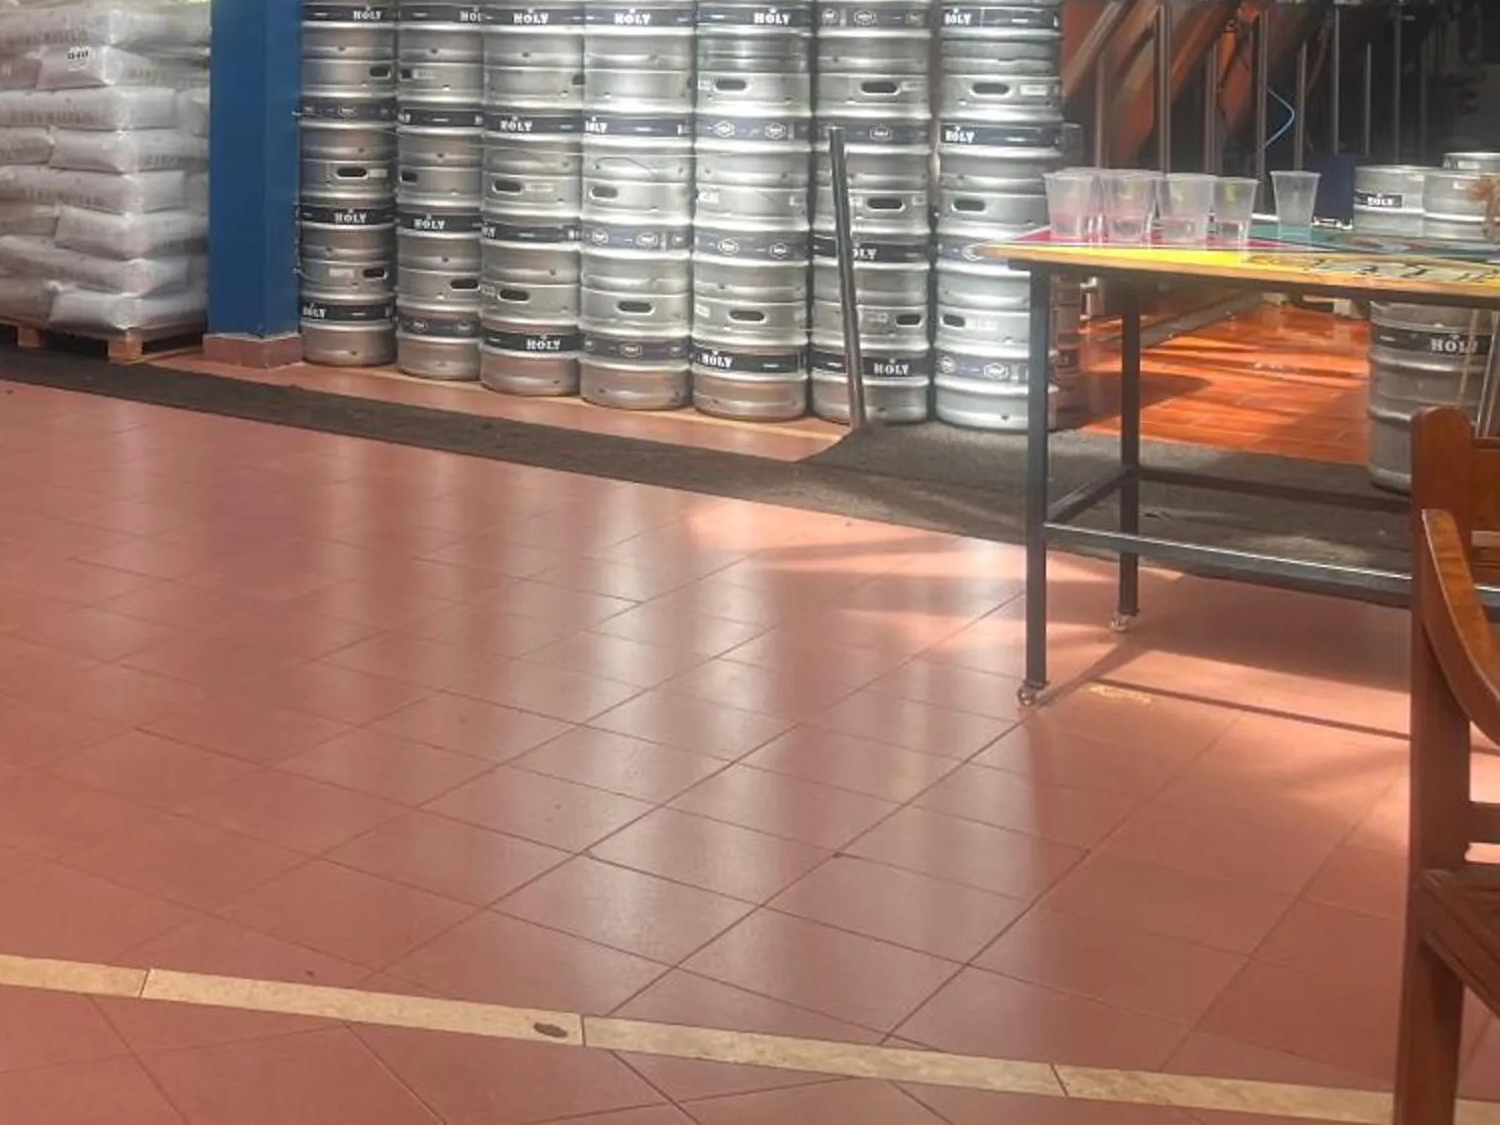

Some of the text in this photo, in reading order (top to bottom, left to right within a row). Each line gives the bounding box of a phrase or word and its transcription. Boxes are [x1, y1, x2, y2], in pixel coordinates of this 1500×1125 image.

[353, 10, 382, 21] HOLY
[513, 12, 549, 24] HOLY
[614, 13, 651, 25] HOLY
[754, 12, 790, 24] HOLY
[335, 212, 367, 224] HOLY
[414, 218, 446, 230] HOLY
[526, 339, 561, 351] HOLY
[702, 354, 733, 368] HOLY
[874, 362, 909, 375] HOLY
